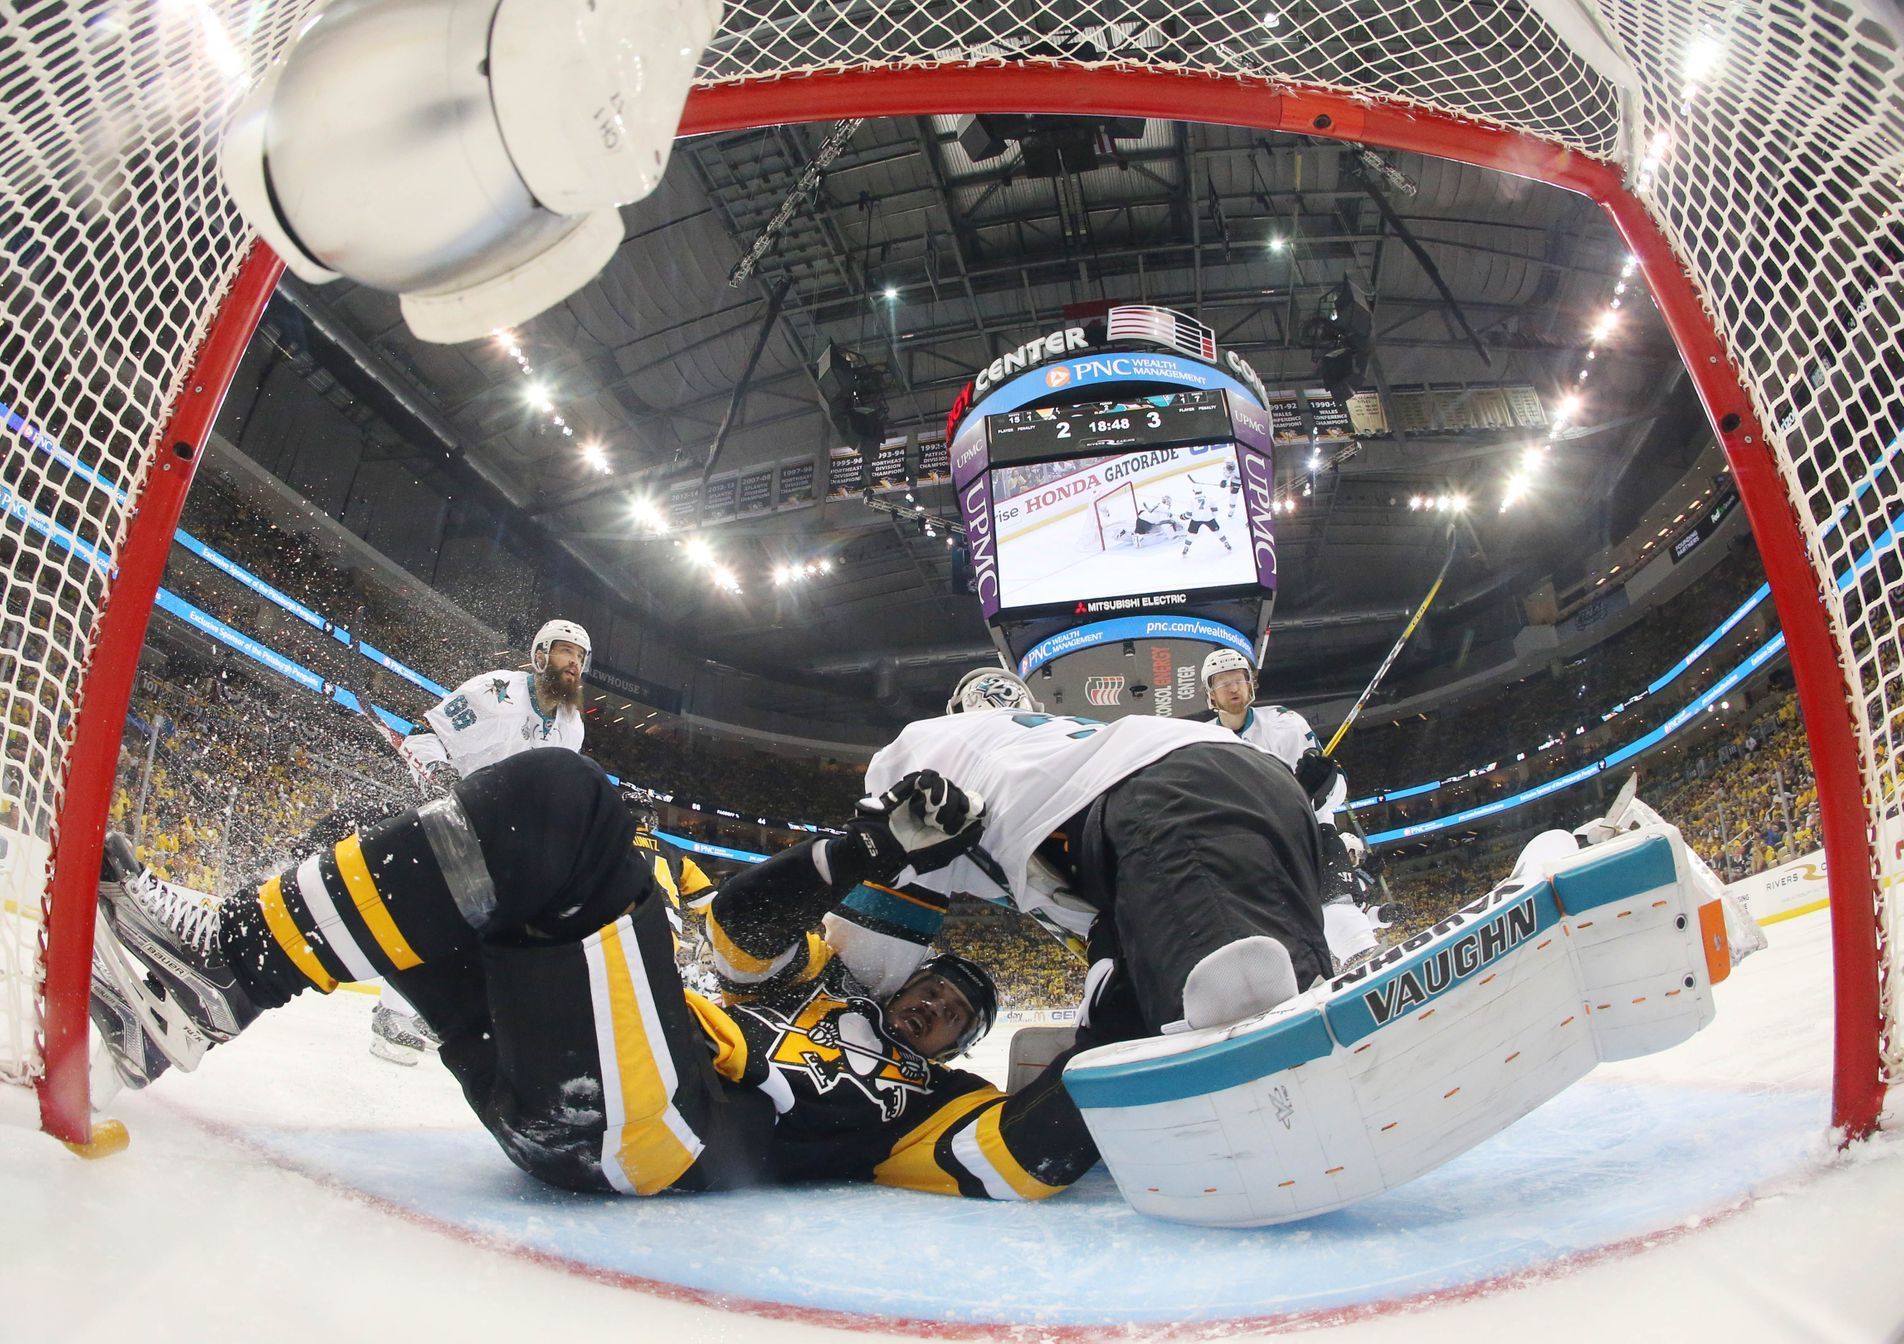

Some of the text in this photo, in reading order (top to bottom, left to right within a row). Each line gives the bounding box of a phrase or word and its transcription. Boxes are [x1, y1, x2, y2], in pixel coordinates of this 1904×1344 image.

[976, 327, 1089, 391] CENTER
[1073, 358, 1177, 381] PNC WEALTH
[1132, 367, 1207, 385] MANAGEMENT
[1056, 411, 1161, 438] 2 18:48 3
[1235, 409, 1265, 436] UPMC
[875, 463, 902, 472] DIVISION
[956, 439, 983, 469] UPMC
[1024, 474, 1102, 515] HONDA
[1104, 446, 1179, 483] GATORADE
[1245, 453, 1277, 575] UPMC
[966, 477, 998, 605] UPMC
[1675, 530, 1698, 552] FOUNDING
[1677, 535, 1700, 557] PARTNERS
[202, 548, 229, 569] Exclusive
[228, 565, 252, 584] Sponsor
[1088, 594, 1187, 612] MITSUBISHI ELECTRIC
[189, 611, 219, 632] Exclusive
[218, 628, 244, 647] Sponsor
[250, 645, 263, 656] the
[1028, 630, 1080, 668] PNC WEALTH
[1052, 632, 1104, 653] MANAGEMENT
[1177, 664, 1196, 700] CENTER
[443, 694, 478, 732] 88
[1766, 872, 1799, 891] RIVERS
[1331, 884, 1525, 993] VAUGHN
[1363, 896, 1537, 1026] VAUGHN
